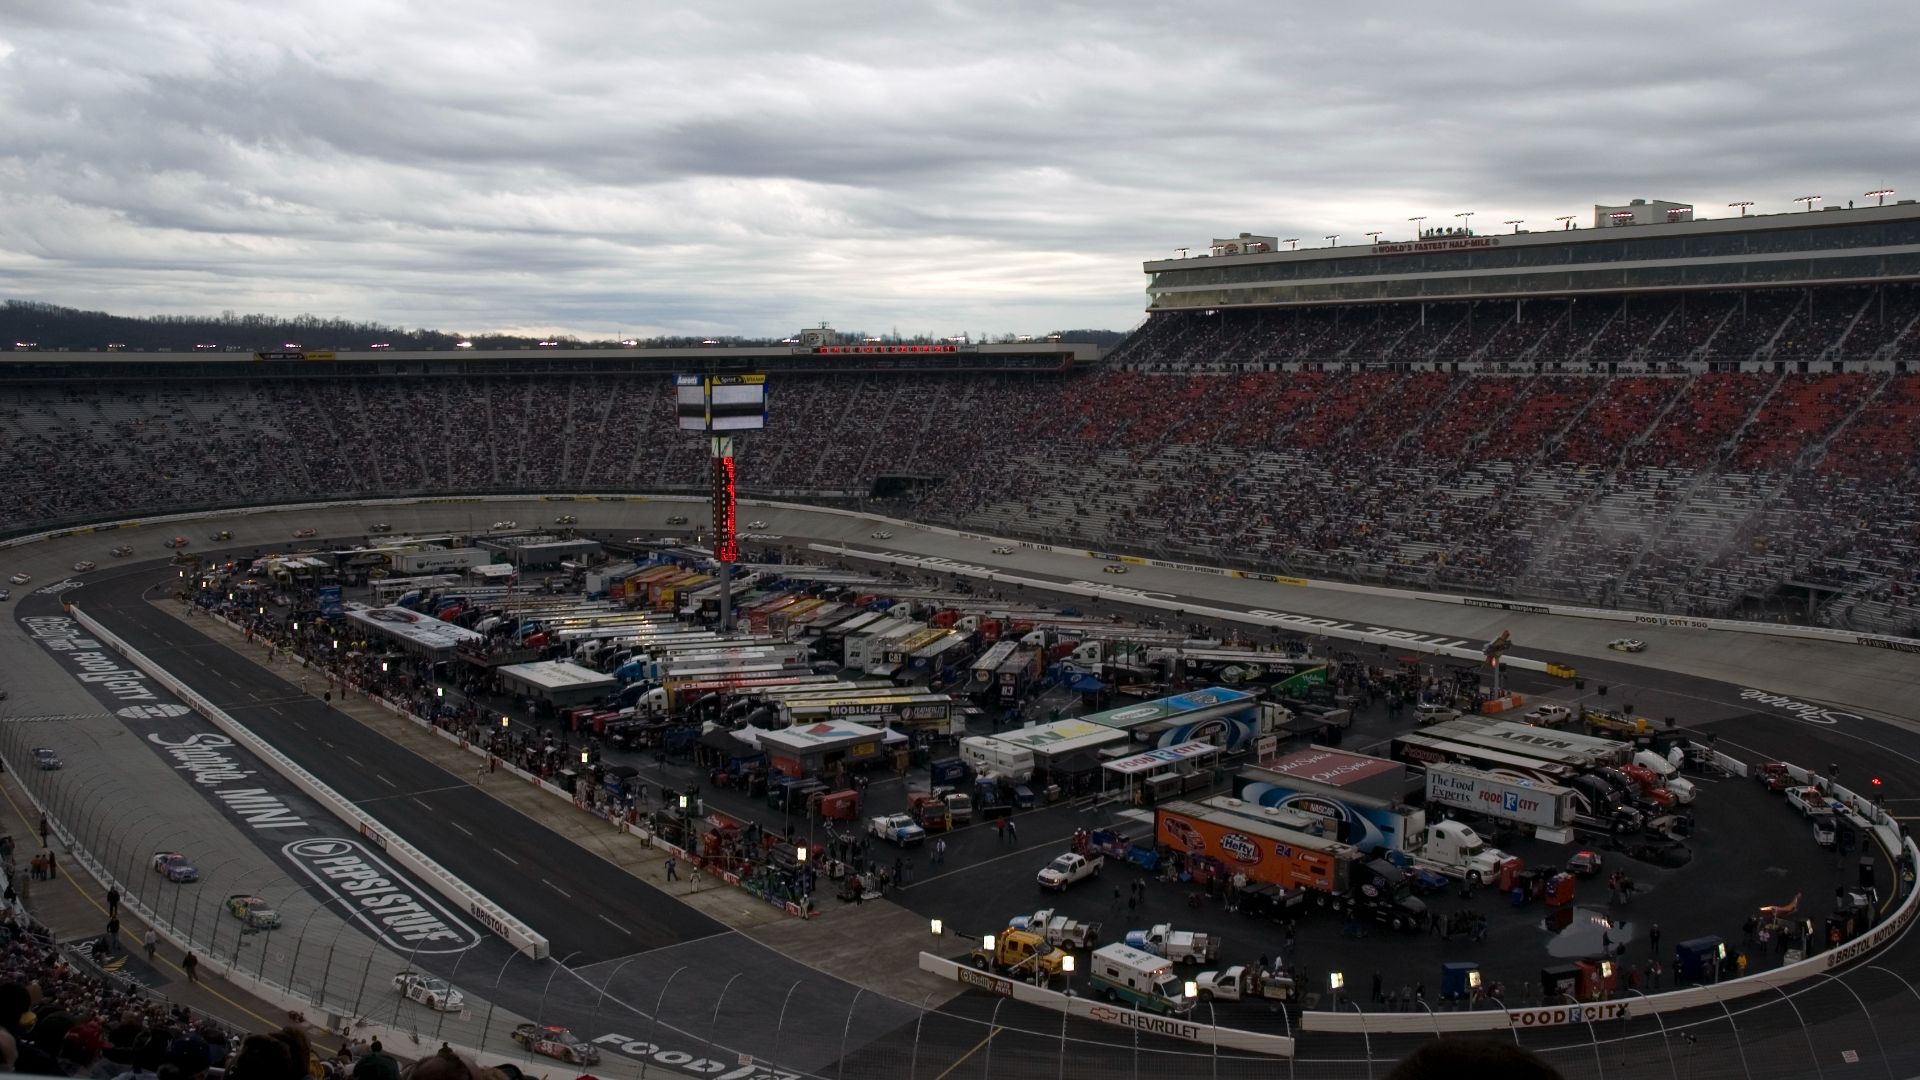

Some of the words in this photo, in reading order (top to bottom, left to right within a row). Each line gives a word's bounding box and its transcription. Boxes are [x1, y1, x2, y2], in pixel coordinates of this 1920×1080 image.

[1378, 244, 1412, 254] WORLD'S
[1414, 242, 1447, 251] FASTEST
[1449, 238, 1491, 249] HALF-MILE
[1176, 563, 1194, 571] MOTOR
[1634, 615, 1658, 625] FOOD
[1669, 619, 1688, 627] CITY
[1691, 621, 1708, 629] 500
[888, 652, 902, 663] CAT
[103, 680, 158, 700] CITY
[830, 703, 893, 717] MOBIL-IZE!
[1493, 731, 1574, 749] NAVY
[147, 733, 257, 783] Sharpie
[1117, 755, 1156, 769] FOOD
[1173, 742, 1205, 754] CITY
[1311, 769, 1341, 782] Old
[1339, 758, 1376, 775] Spice
[1432, 773, 1449, 786] The
[1450, 778, 1475, 793] Food
[1432, 785, 1471, 802] Experts
[214, 788, 310, 829] MINI
[1309, 802, 1336, 817] NASCAR
[1479, 790, 1503, 804] FOOD
[1518, 799, 1540, 812] CITY
[1224, 838, 1253, 856] Hefty
[312, 855, 401, 897] PEPSI
[359, 890, 459, 943] STUFF
[474, 906, 506, 938] BRISTOL
[1835, 939, 1871, 964] BRISTOL
[1873, 920, 1897, 944] MOTOR
[1508, 1009, 1566, 1027] FOOD
[1584, 1002, 1630, 1021] CITY
[1119, 1010, 1200, 1041] CHEVROLET
[591, 1032, 727, 1073] FOOD
